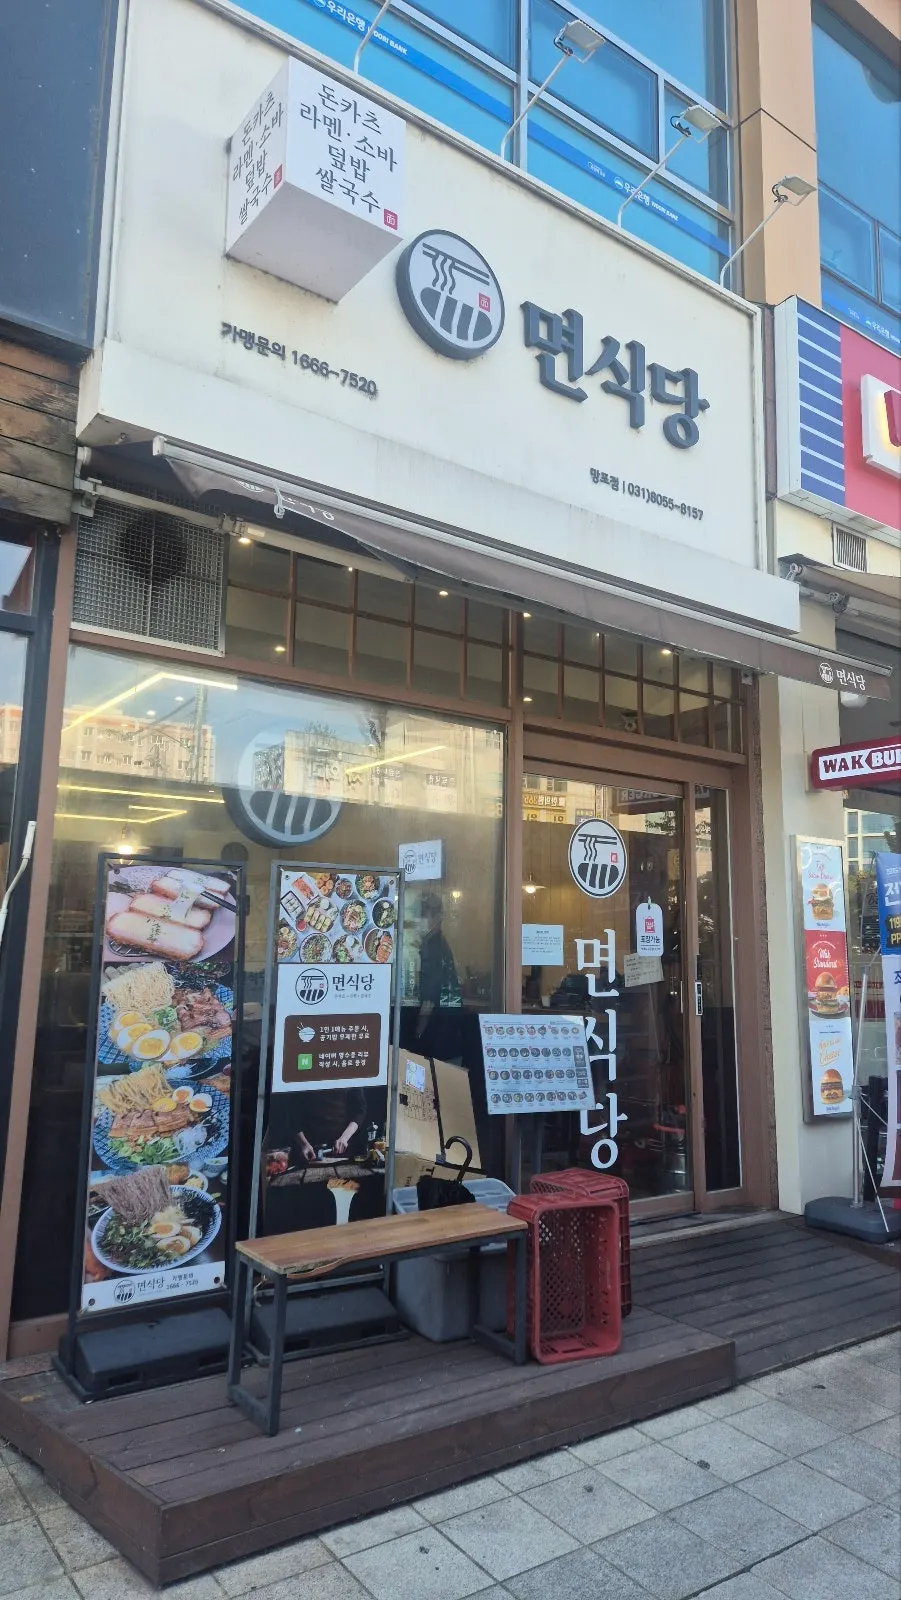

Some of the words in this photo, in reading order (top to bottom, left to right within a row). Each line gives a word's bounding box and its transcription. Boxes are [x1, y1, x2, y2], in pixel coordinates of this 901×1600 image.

[327, 0, 366, 32] 우리은행
[389, 40, 408, 55] BANK
[241, 91, 275, 147] 돈카츠
[318, 83, 382, 135] 돈카츠
[245, 149, 268, 193] 덮밥
[327, 144, 371, 184] 덮밥
[239, 172, 273, 226] 쌀국수
[315, 167, 381, 214] 쌀국수
[221, 320, 286, 361] 가맹문의
[291, 350, 378, 397] 1666-7520
[520, 300, 710, 450] 면식당
[590, 467, 619, 492] 망포점
[836, 669, 866, 690] 면식당
[823, 755, 865, 774] WAK
[332, 973, 375, 991] 면식당
[137, 1276, 165, 1292] 면식당
